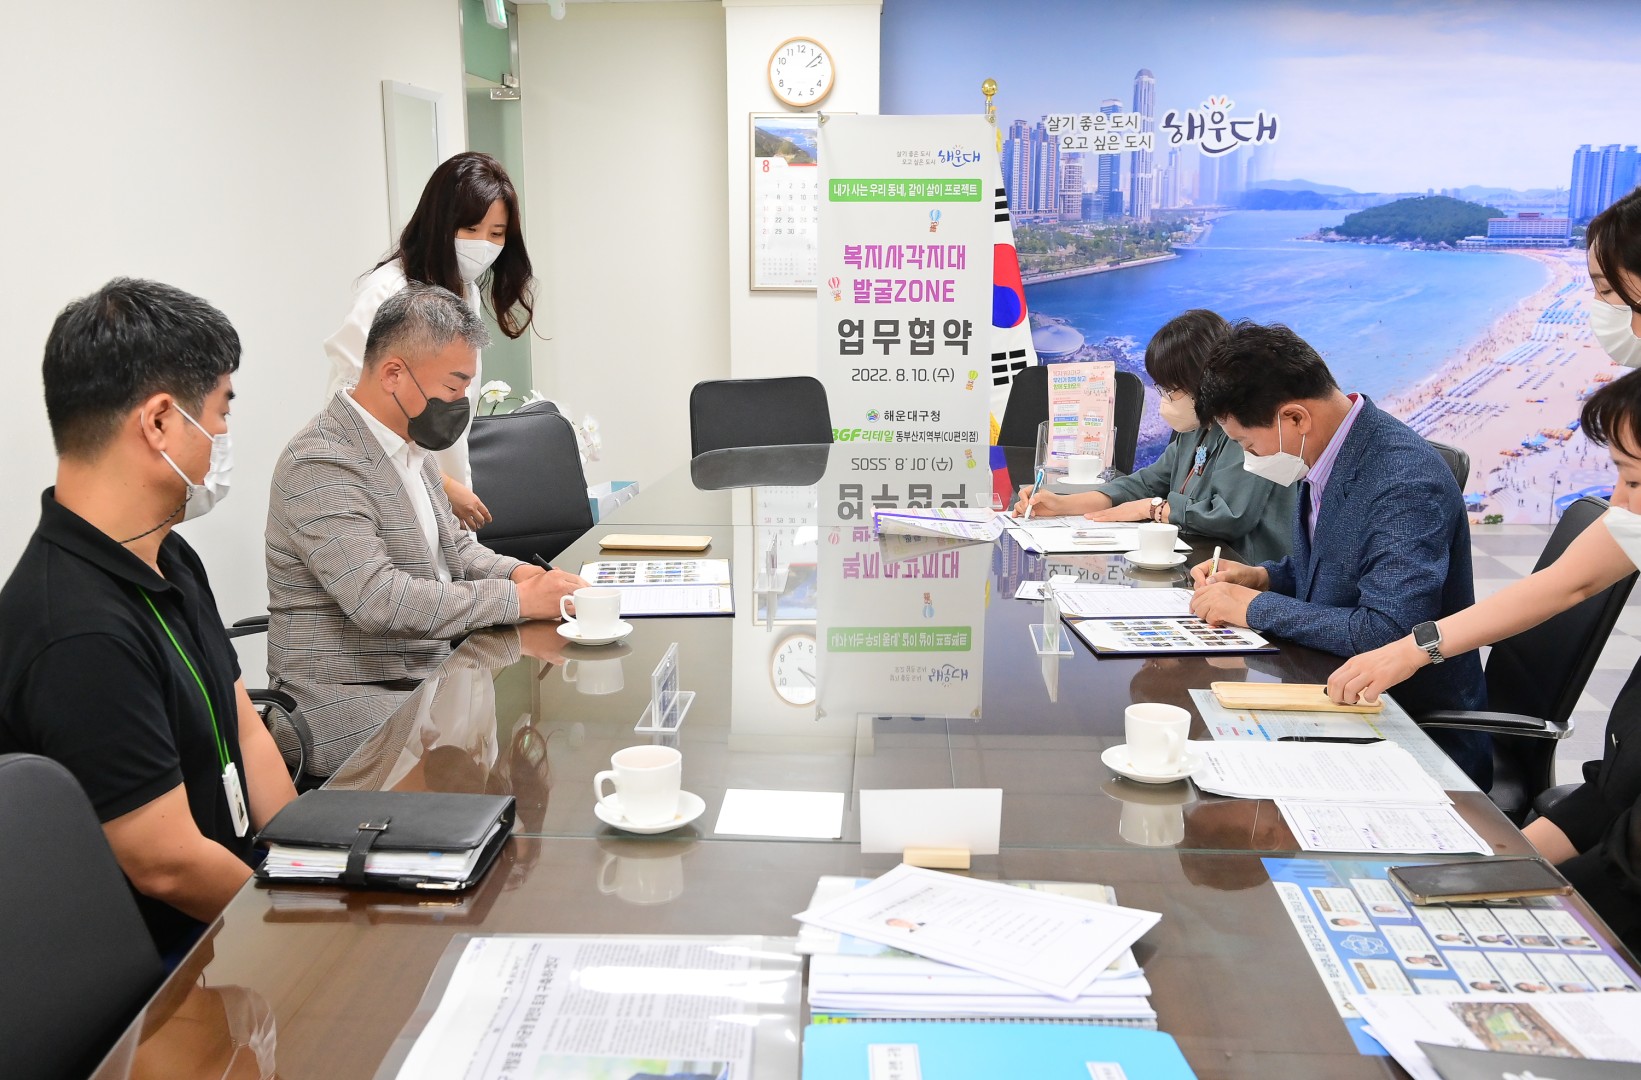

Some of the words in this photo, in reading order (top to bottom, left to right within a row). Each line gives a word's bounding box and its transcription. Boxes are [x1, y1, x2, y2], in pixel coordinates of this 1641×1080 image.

[786, 48, 794, 57] 11
[797, 44, 806, 54] 12
[778, 57, 787, 65] 10
[778, 79, 784, 88] 8
[816, 79, 822, 87] 4
[787, 87, 792, 96] 7
[809, 87, 815, 96] 5
[1047, 116, 1075, 132] 살기
[1079, 115, 1107, 132] 좋은
[1111, 115, 1139, 130] 도시
[1162, 111, 1277, 154] 해운대
[1061, 137, 1089, 150] 오고
[1093, 135, 1120, 151] 싶은
[1124, 135, 1152, 149] 도시
[920, 150, 931, 158] 도시
[938, 149, 980, 167] 해운대
[762, 159, 770, 173] 8
[833, 184, 850, 197] 내가
[852, 184, 868, 197] 사는
[869, 184, 886, 197] 우리
[888, 184, 907, 198] 동네,
[908, 184, 925, 197] 같이
[926, 184, 943, 197] 살이
[944, 184, 978, 197] 프로젝트
[843, 244, 966, 270] 복지사각지대
[853, 279, 955, 304] 발굴ZONE
[837, 317, 973, 356] 업무협약
[851, 368, 892, 382] 2022.
[883, 410, 941, 422] 해운대구청
[895, 431, 979, 443] 동부산지역부(CU편의점)
